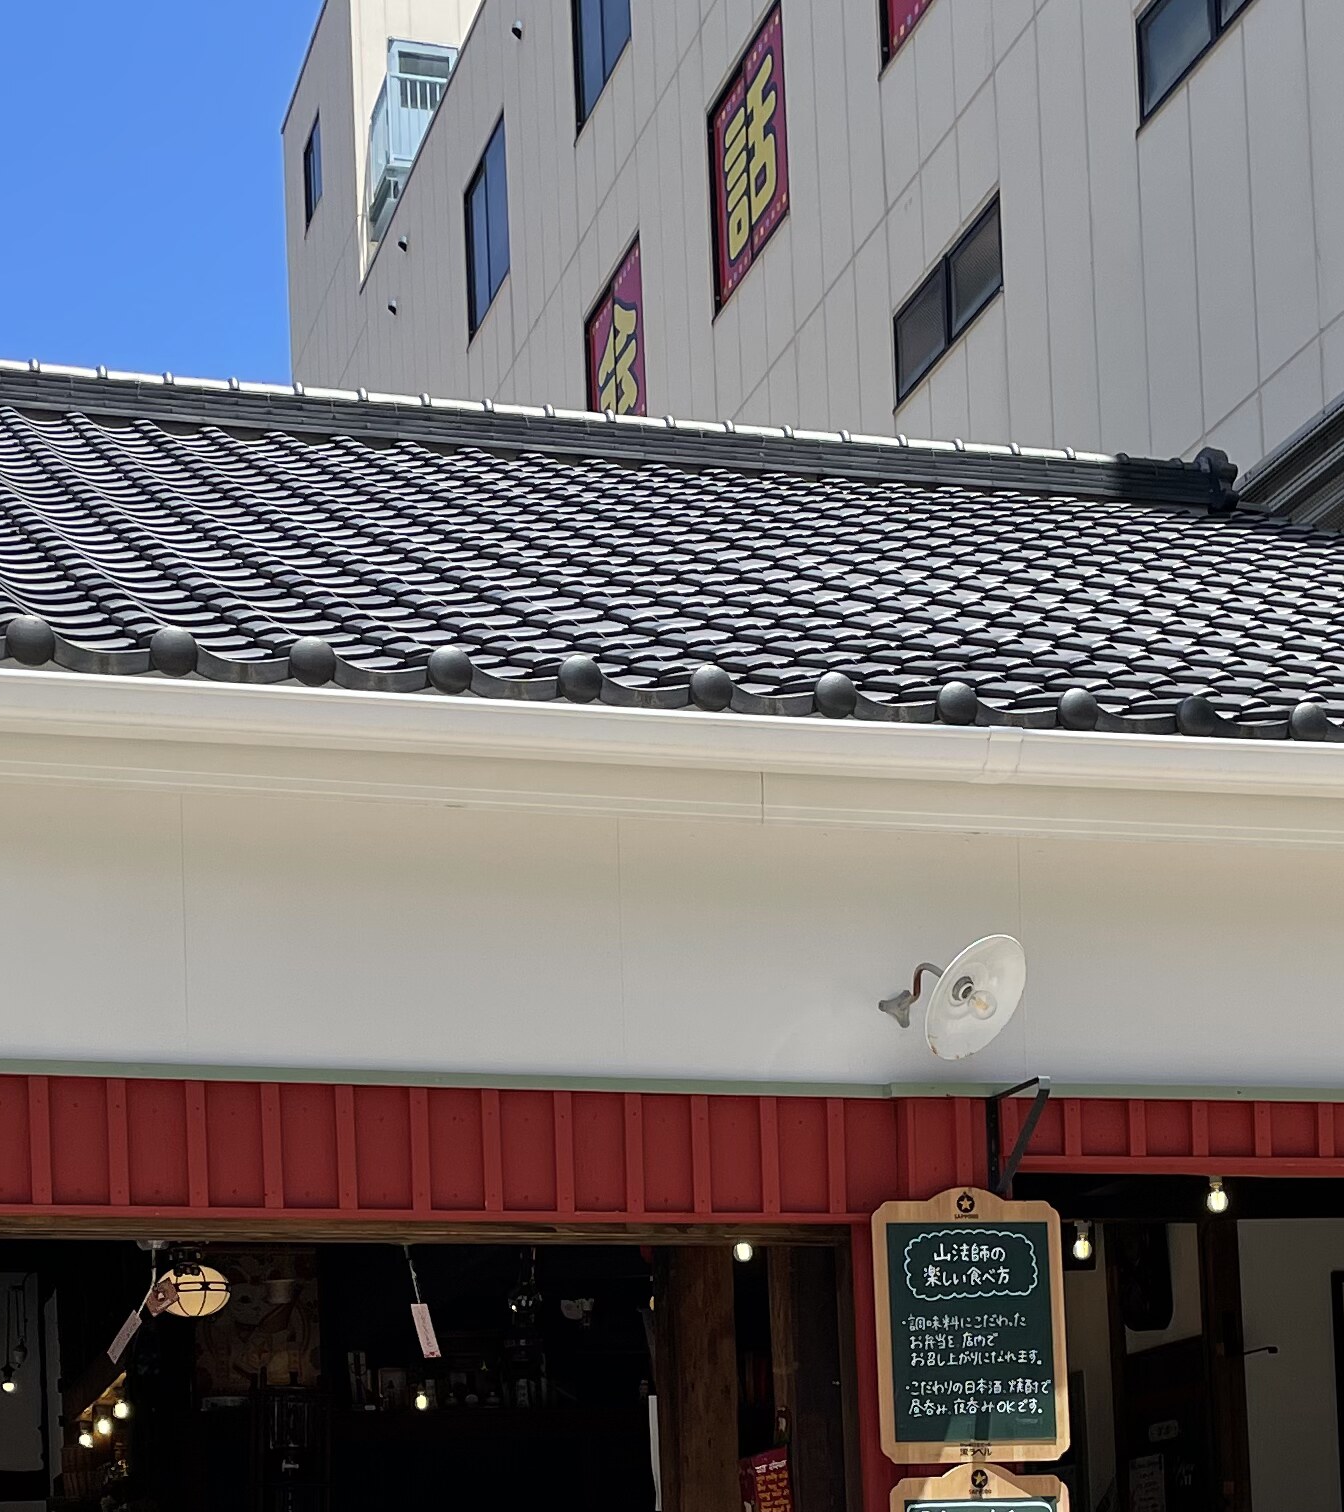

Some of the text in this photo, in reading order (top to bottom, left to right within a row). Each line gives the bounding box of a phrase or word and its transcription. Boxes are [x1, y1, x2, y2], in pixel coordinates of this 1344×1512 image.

[724, 53, 776, 261] 話
[933, 1243, 1006, 1262] 山法師の
[923, 1266, 1010, 1287] 楽しい食べ方
[910, 1349, 1043, 1367] お召し上がりになれます。
